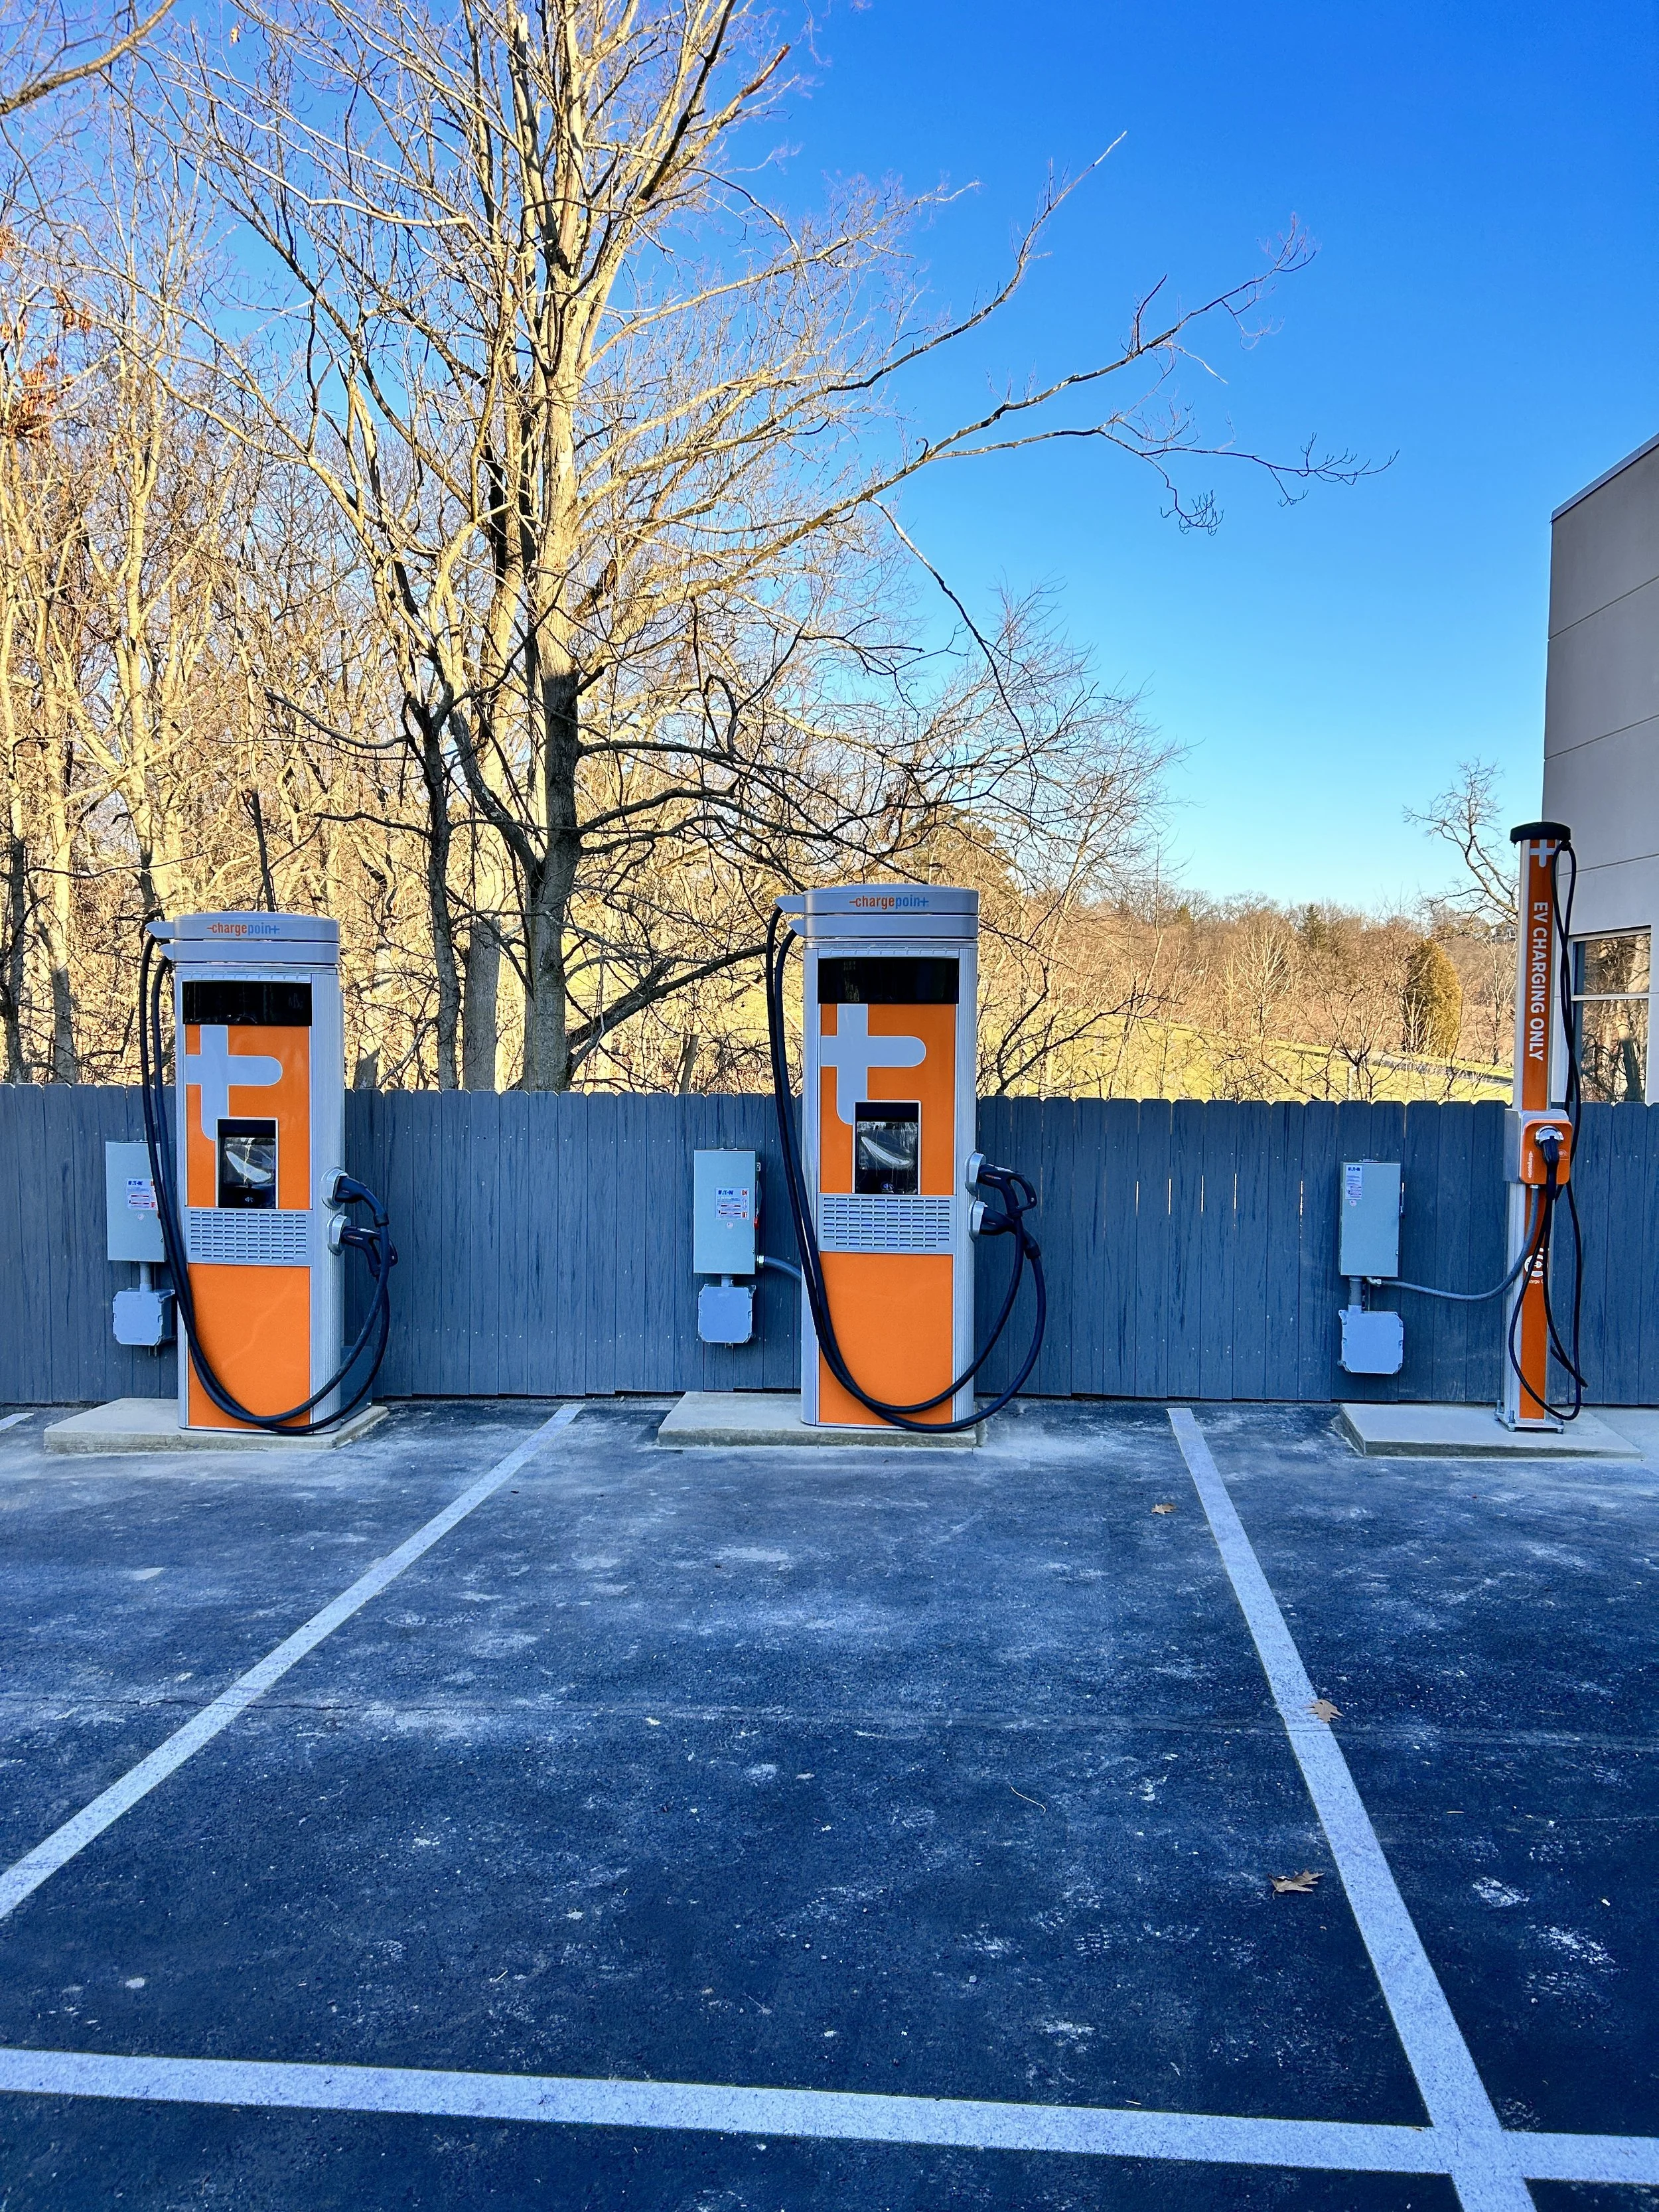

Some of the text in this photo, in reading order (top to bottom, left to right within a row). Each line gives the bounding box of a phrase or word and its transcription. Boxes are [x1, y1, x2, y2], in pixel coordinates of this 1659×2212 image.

[1529, 903, 1548, 1061] EV CHARGING ONLY
